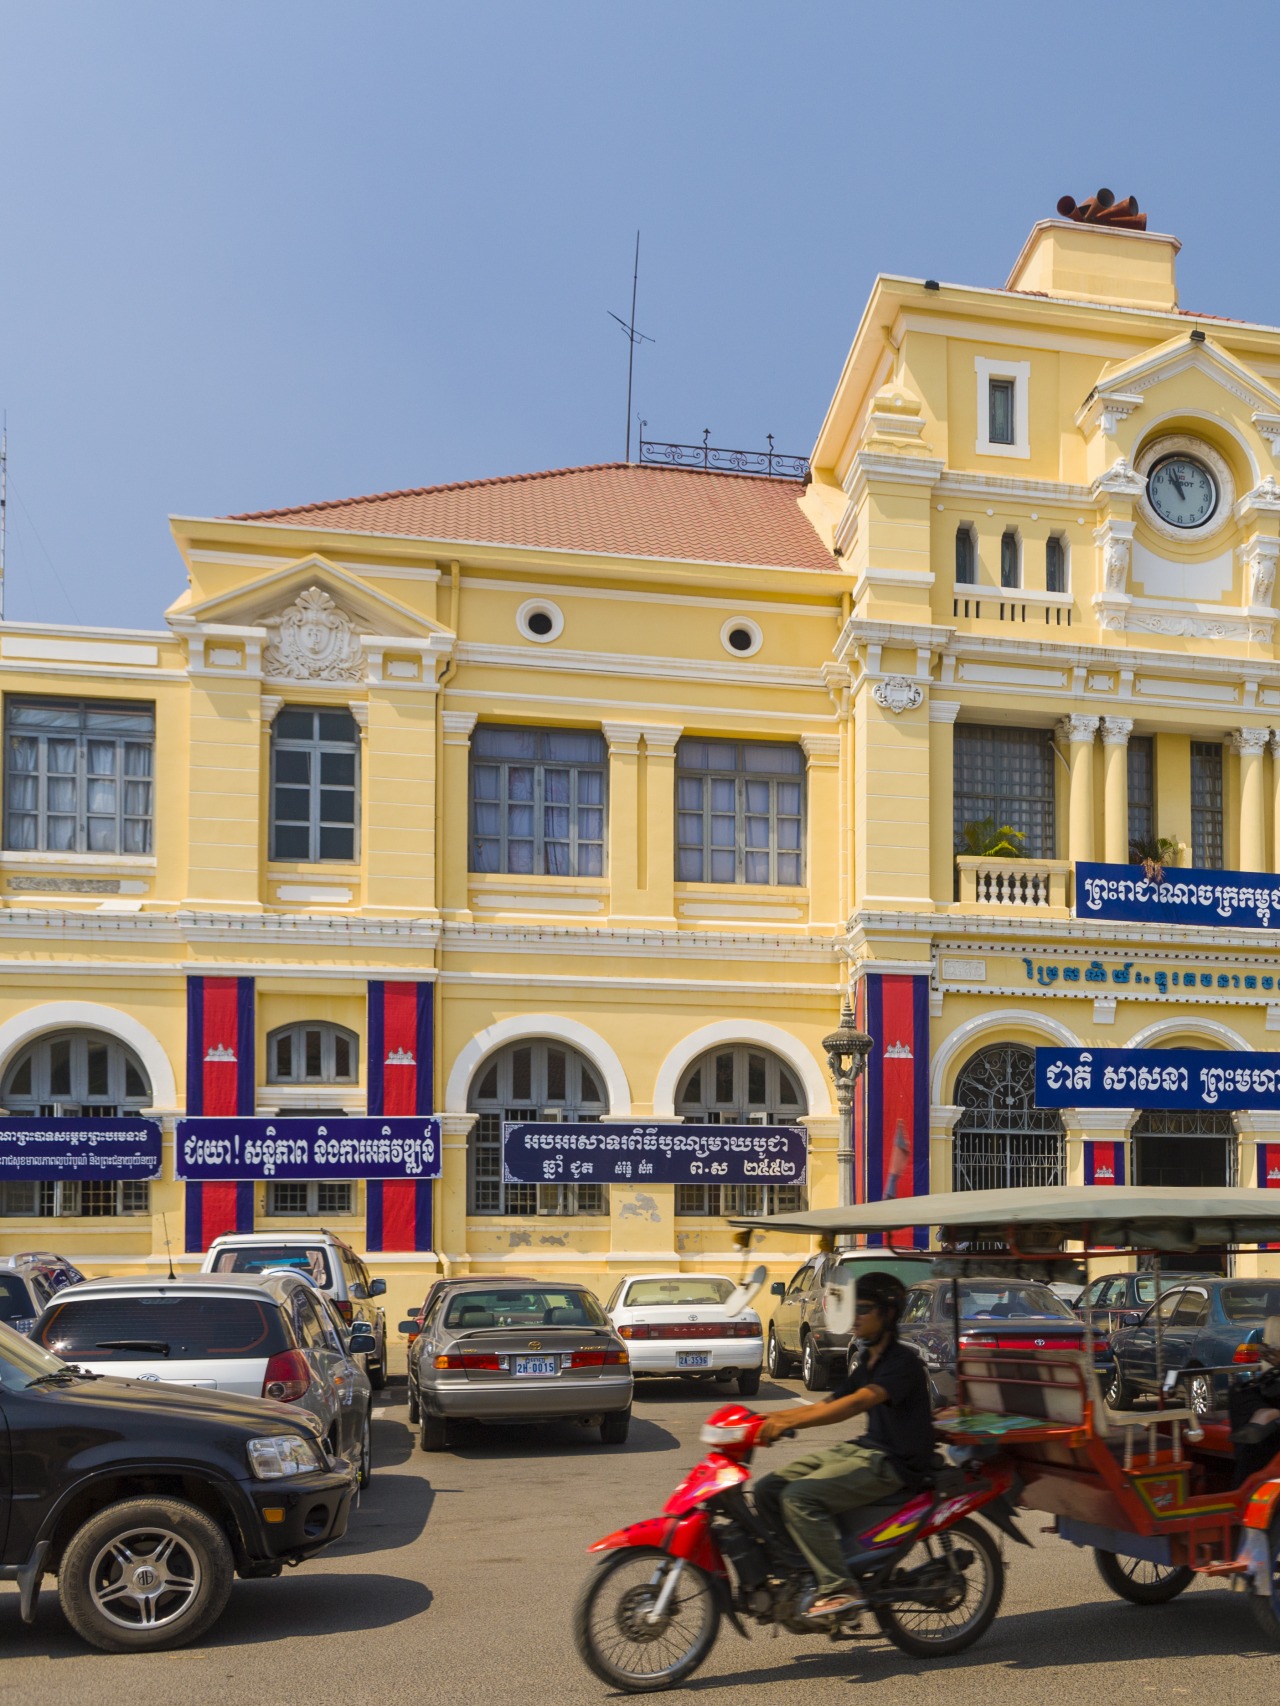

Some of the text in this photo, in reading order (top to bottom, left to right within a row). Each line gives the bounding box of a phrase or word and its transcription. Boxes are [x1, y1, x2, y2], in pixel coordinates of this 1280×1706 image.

[1178, 466, 1185, 474] 12
[1156, 476, 1164, 484] 10
[1199, 480, 1205, 488] 2
[1203, 494, 1208, 502] 3
[1189, 514, 1195, 522] 5
[1047, 1053, 1092, 1089] ជាតិ
[1104, 1066, 1187, 1090] សាសនា
[524, 1128, 789, 1158] អបអរសាទរពិធីបុណ្យមាឃបូជា
[517, 1362, 554, 1374] 2H-0015
